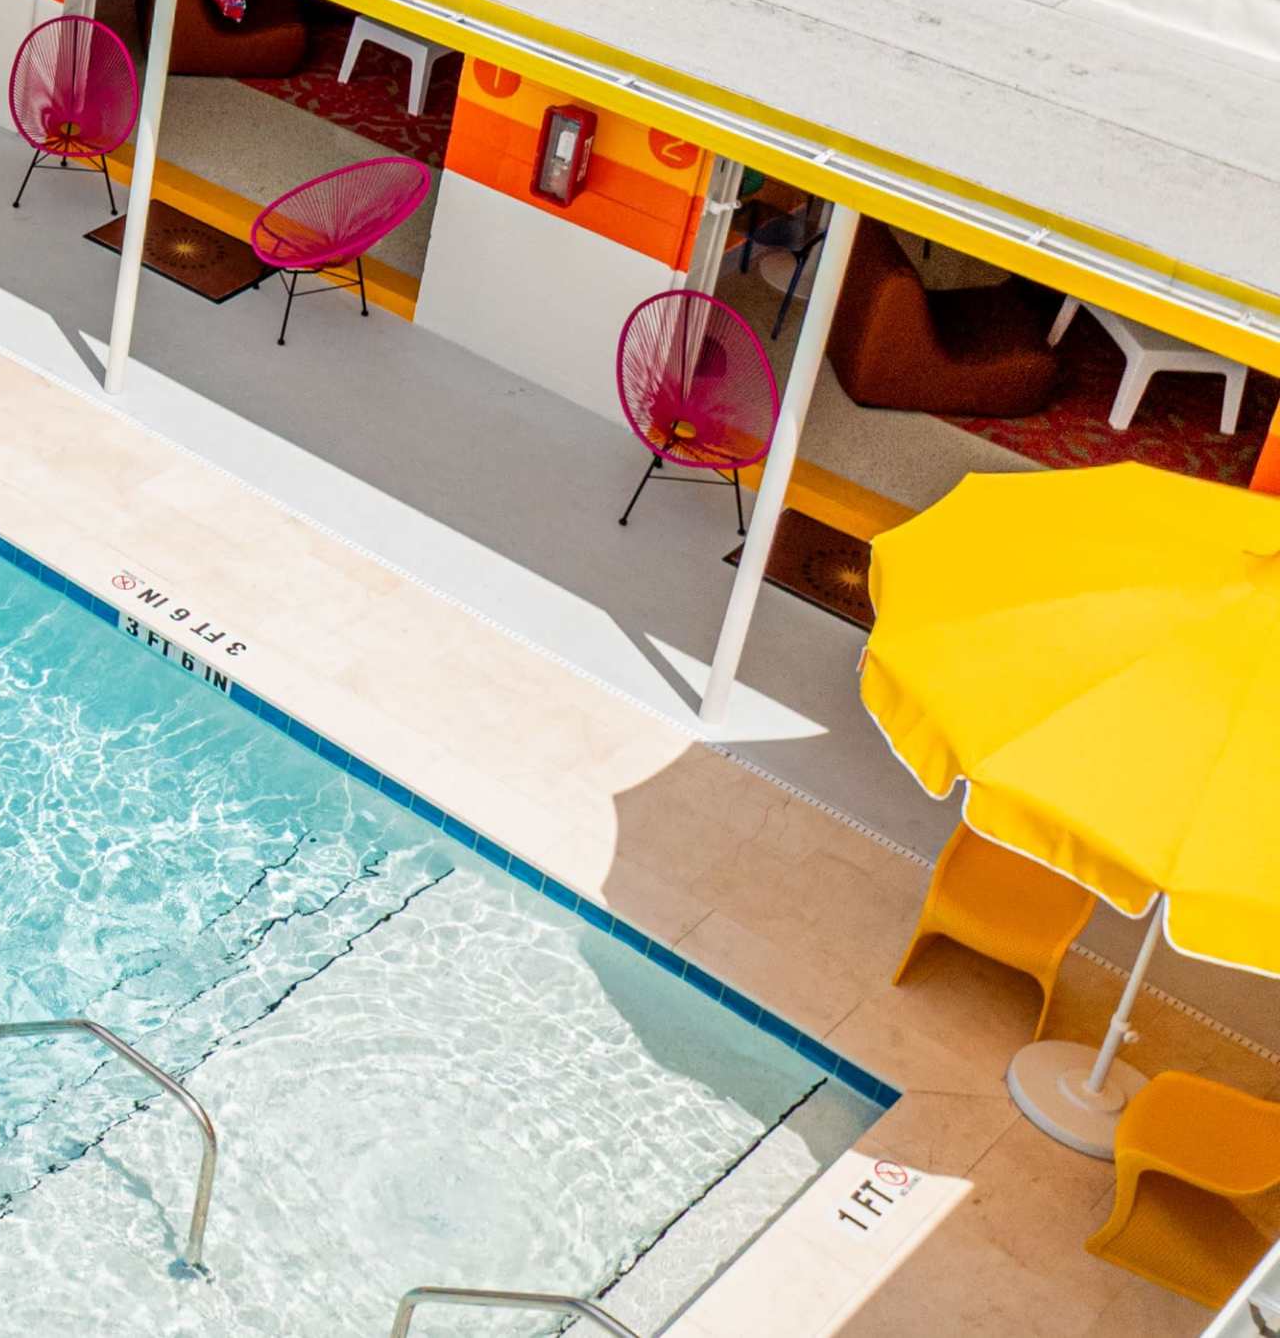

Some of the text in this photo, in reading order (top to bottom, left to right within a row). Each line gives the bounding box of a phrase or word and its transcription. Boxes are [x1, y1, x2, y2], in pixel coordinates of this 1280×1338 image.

[126, 617, 228, 693] 3 FT 6 IN
[137, 588, 247, 656] 3 FT 6 IN
[838, 1179, 894, 1230] 1 FT
